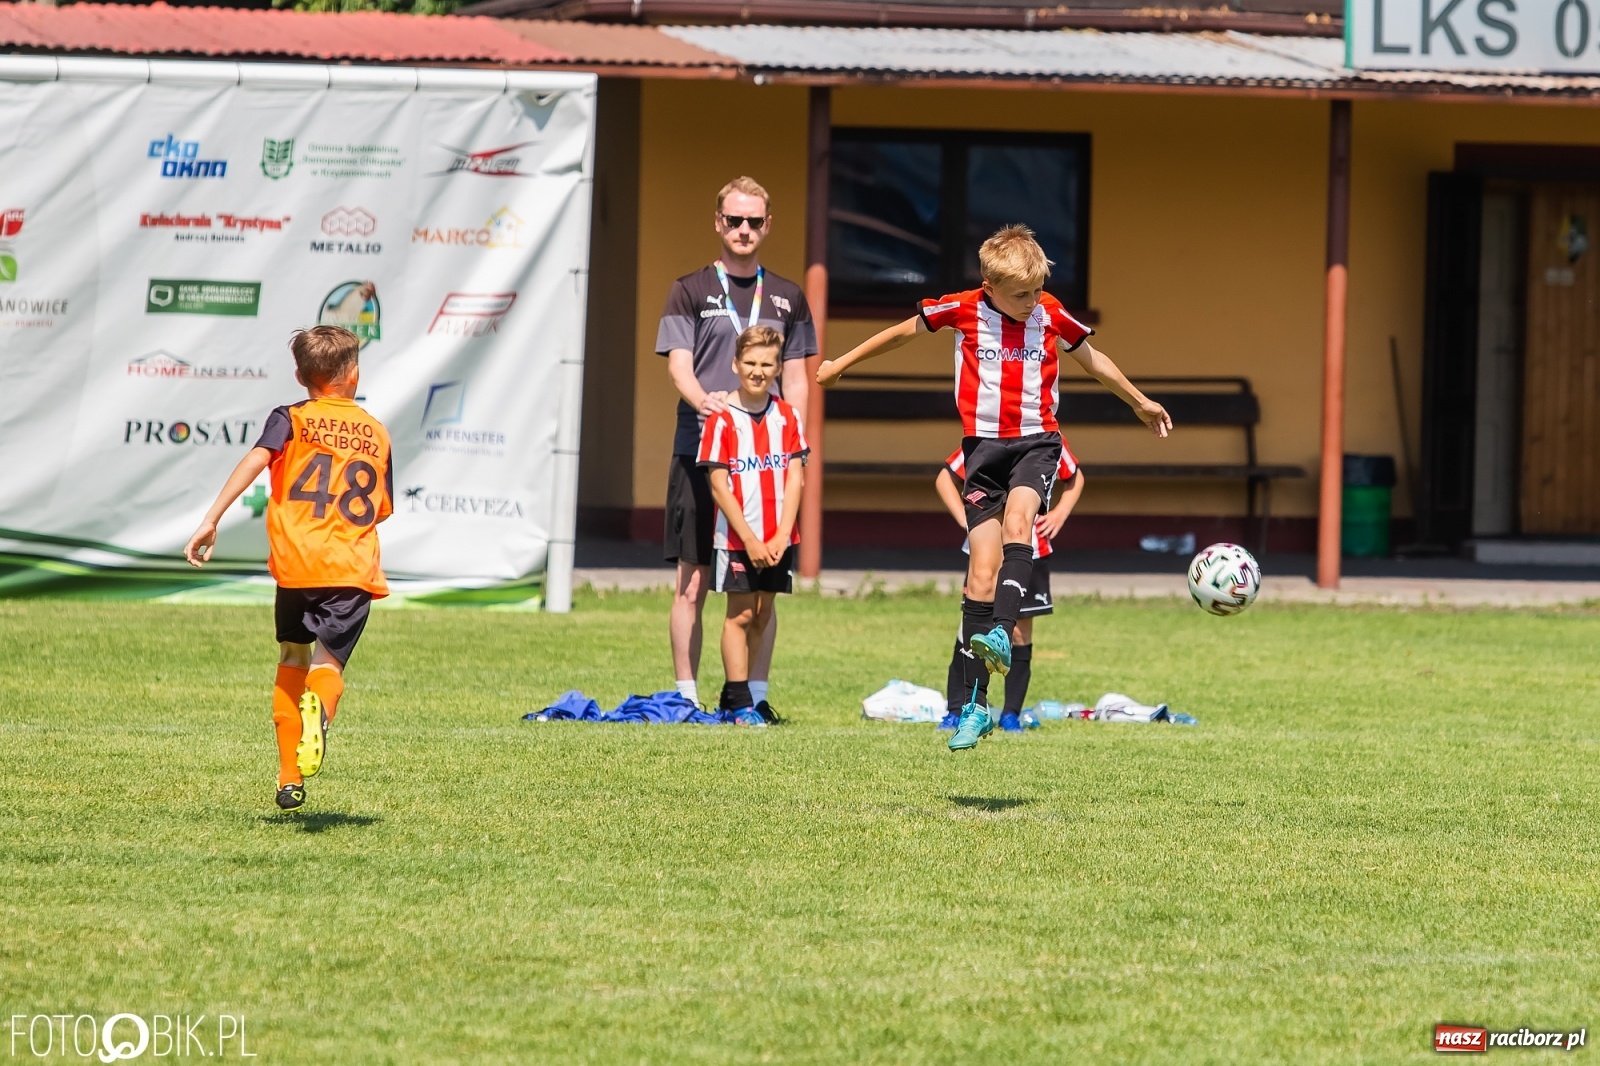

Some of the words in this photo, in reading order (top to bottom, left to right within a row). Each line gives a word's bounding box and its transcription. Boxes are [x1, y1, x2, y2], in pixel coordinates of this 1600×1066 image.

[1372, 0, 1519, 57] LKS
[1555, 0, 1600, 58] 0
[411, 225, 491, 246] MARCO
[310, 240, 382, 254] METALIO
[0, 298, 68, 316] NOWICE
[700, 308, 730, 319] COMARC
[975, 347, 1046, 362] COMARCH
[124, 419, 256, 446] PROSAT
[306, 417, 373, 438] RAFAKO
[446, 429, 505, 445] FENSTER
[300, 427, 379, 459] RACIBÓRZ
[287, 452, 378, 528] 48
[425, 494, 524, 518] CERVEZA
